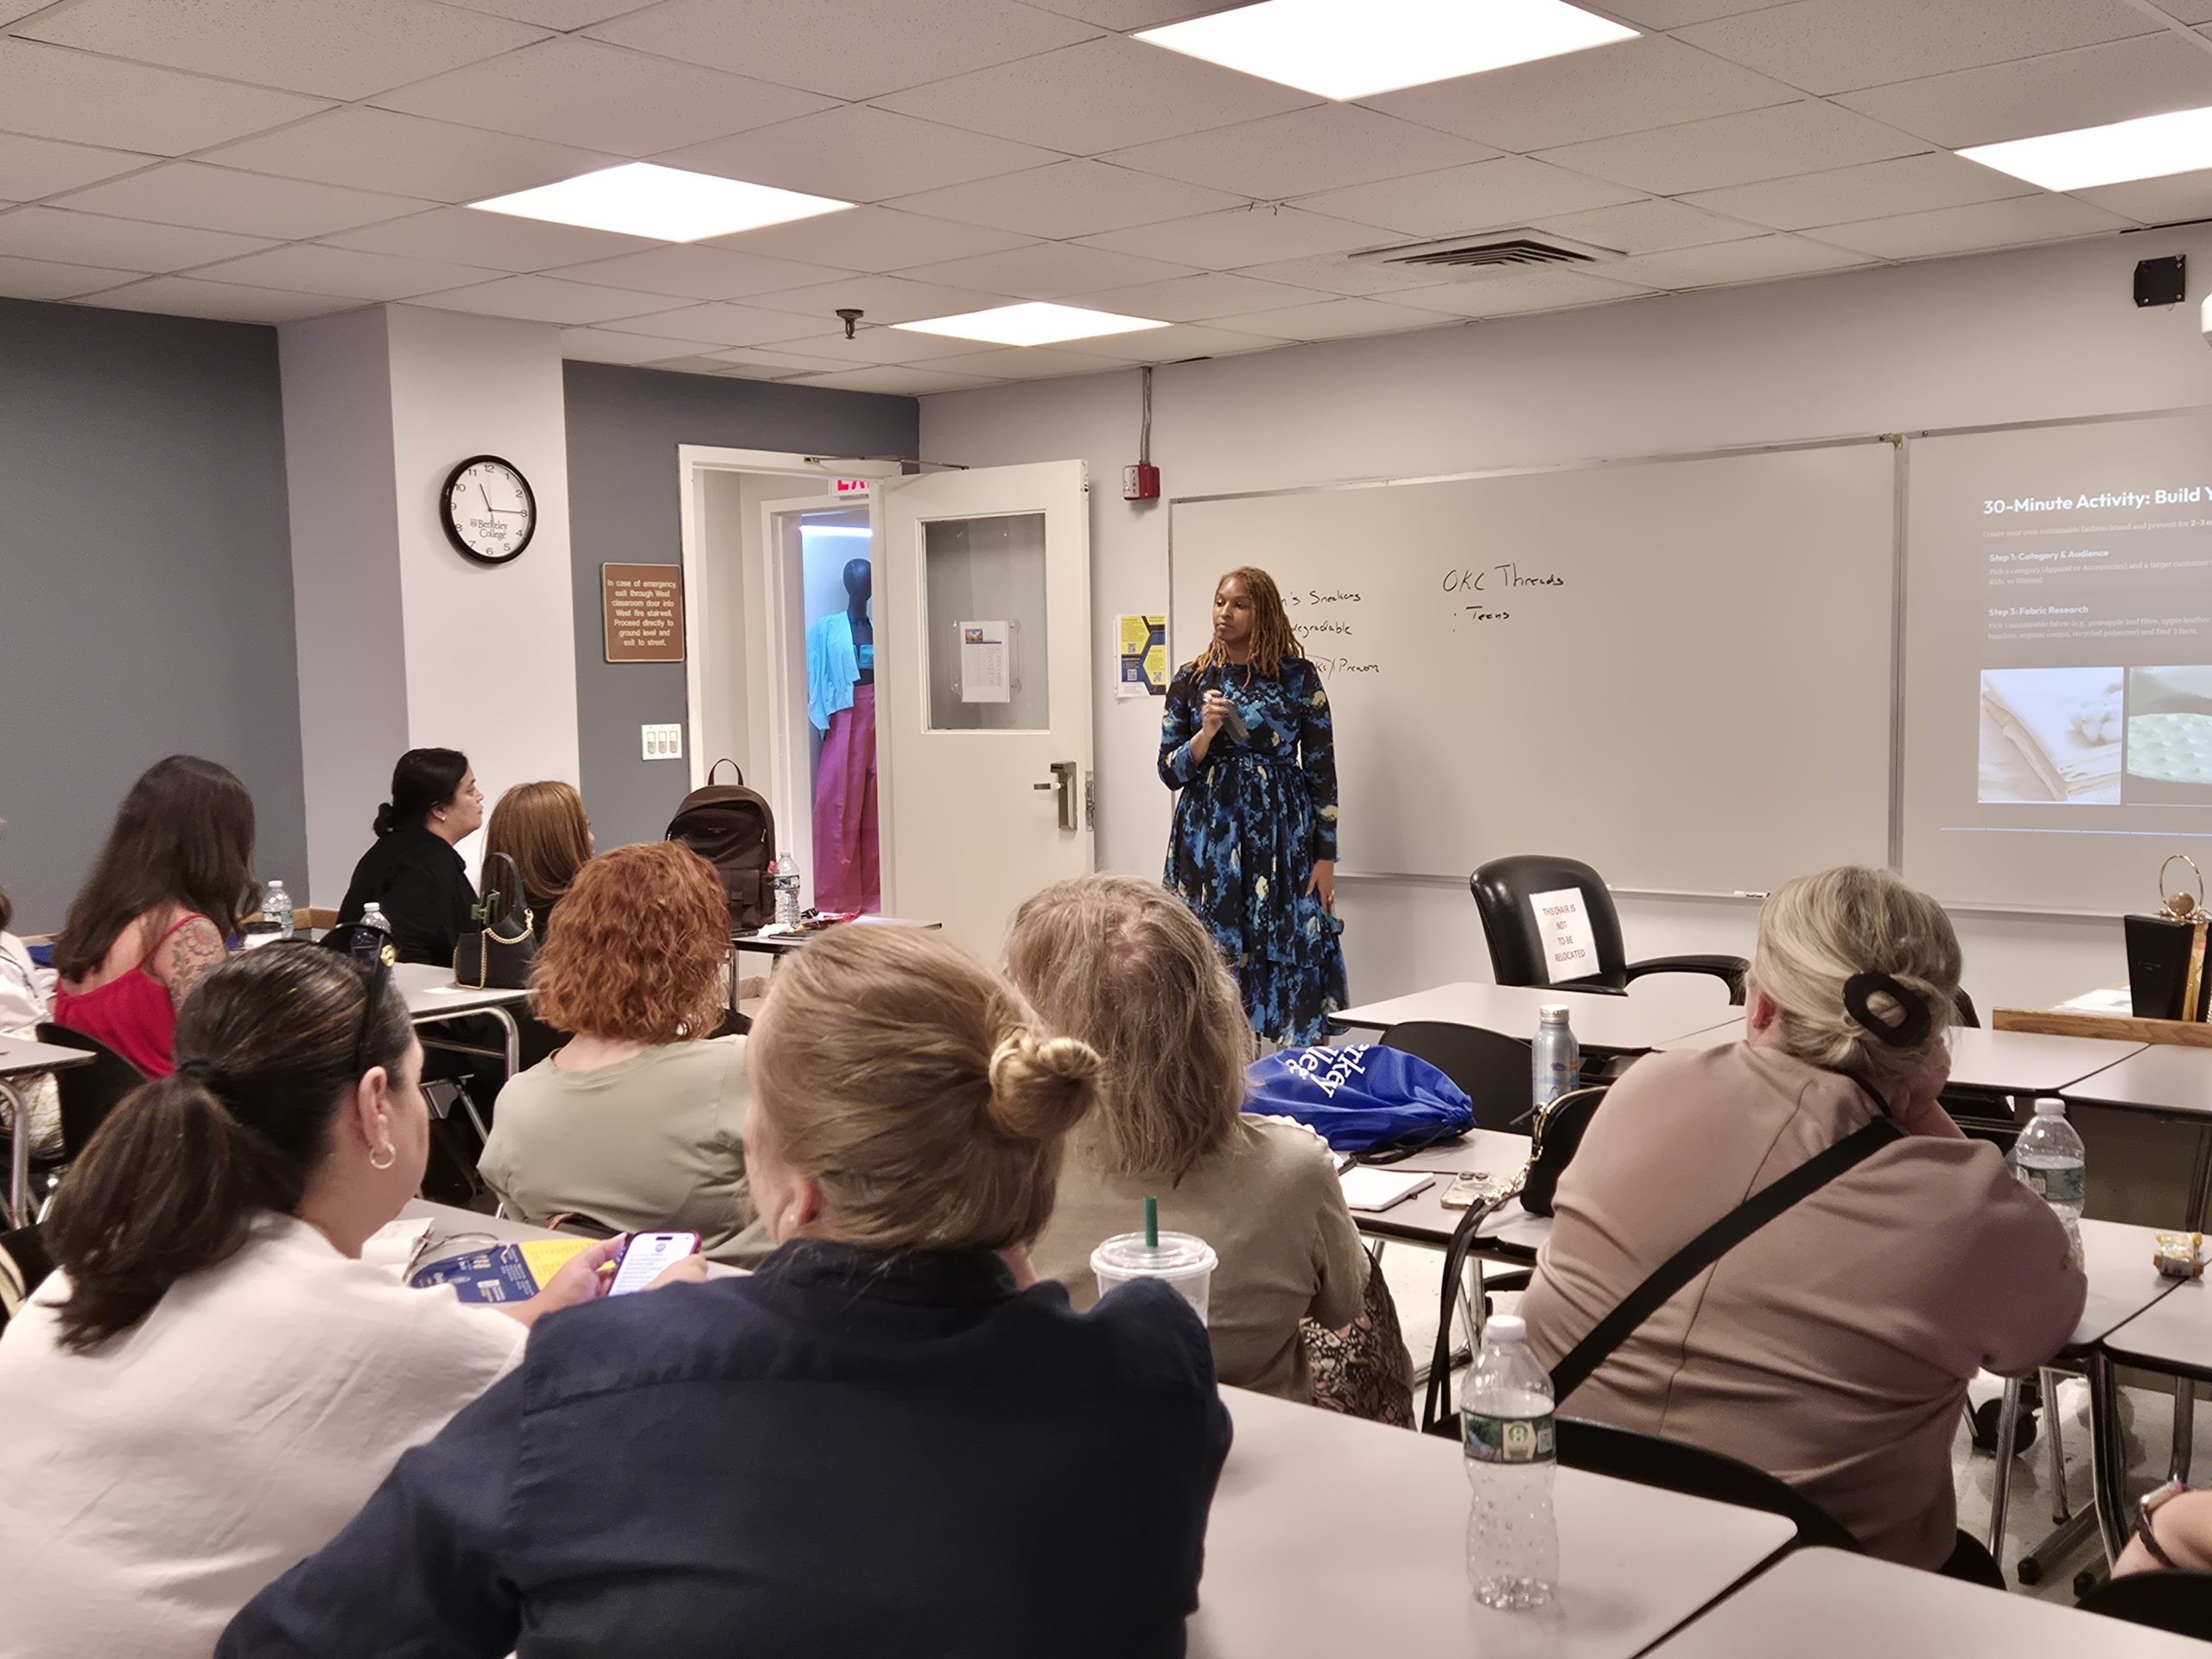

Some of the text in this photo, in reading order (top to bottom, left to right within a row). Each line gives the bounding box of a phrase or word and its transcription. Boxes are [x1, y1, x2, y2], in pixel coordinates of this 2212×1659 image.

[467, 468, 477, 477] 11
[454, 483, 467, 492] 10
[515, 489, 523, 498] 2
[1984, 497, 2073, 514] 30-Minute
[2076, 492, 2151, 509] Activity:
[2155, 486, 2201, 504] Build
[450, 502, 457, 511] 9
[455, 524, 463, 532] 8
[480, 529, 506, 541] College
[1989, 553, 2009, 563] Step
[2018, 551, 2058, 561] Category
[2068, 550, 2109, 558] Audience
[1442, 562, 1564, 592] OKC Threads
[630, 589, 654, 598] through
[1988, 608, 2009, 617] Step
[2019, 607, 2047, 615] Fabric
[2048, 605, 2089, 614] Research
[642, 619, 664, 627] directly
[619, 629, 640, 638] ground
[1292, 620, 1353, 639] degradable
[1542, 904, 1576, 916] THIS CHAIR IS
[1556, 920, 1567, 930] NOT
[1558, 935, 1573, 945] TO BE
[1554, 949, 1586, 962] RELOCATED
